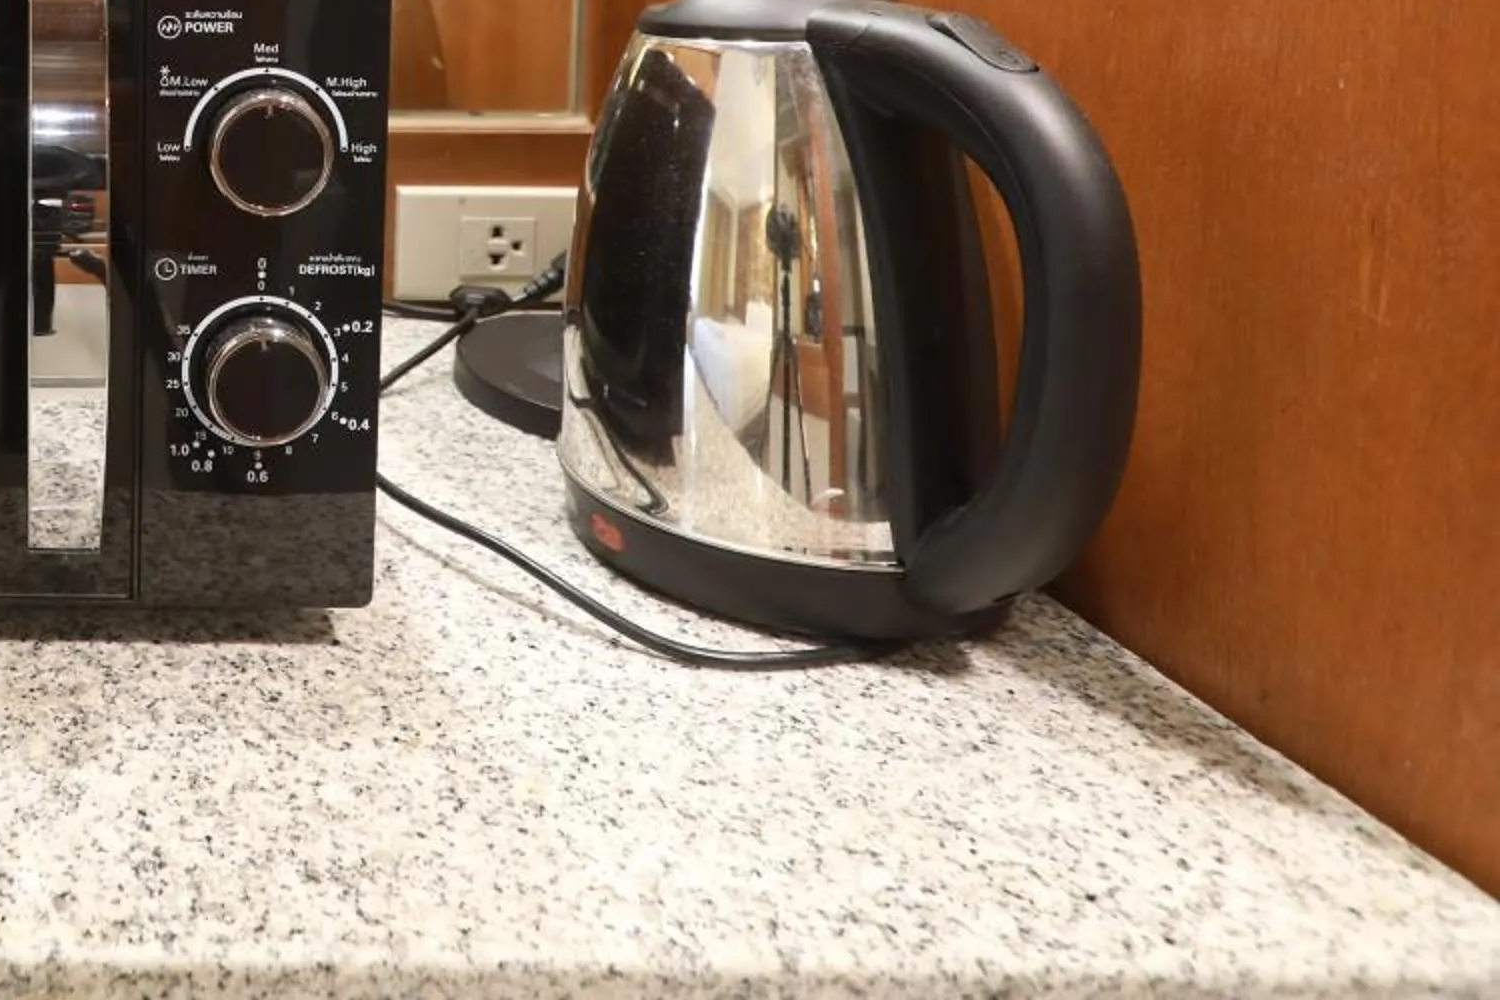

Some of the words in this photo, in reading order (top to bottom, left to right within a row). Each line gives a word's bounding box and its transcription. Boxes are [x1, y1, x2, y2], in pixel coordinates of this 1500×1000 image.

[184, 21, 234, 33] POWER
[253, 43, 279, 53] Med
[326, 76, 367, 89] M.High
[157, 142, 181, 152] Low
[351, 142, 377, 155] High
[180, 263, 217, 275] TIMER
[315, 302, 322, 311] 2
[352, 321, 373, 333] 0.2
[167, 352, 181, 361] 30
[341, 354, 349, 363] 4
[166, 380, 180, 389] 25
[349, 419, 370, 431] 0.4
[170, 444, 189, 456] 1.0
[191, 460, 213, 472] 0.8
[247, 470, 268, 483] 0.6
